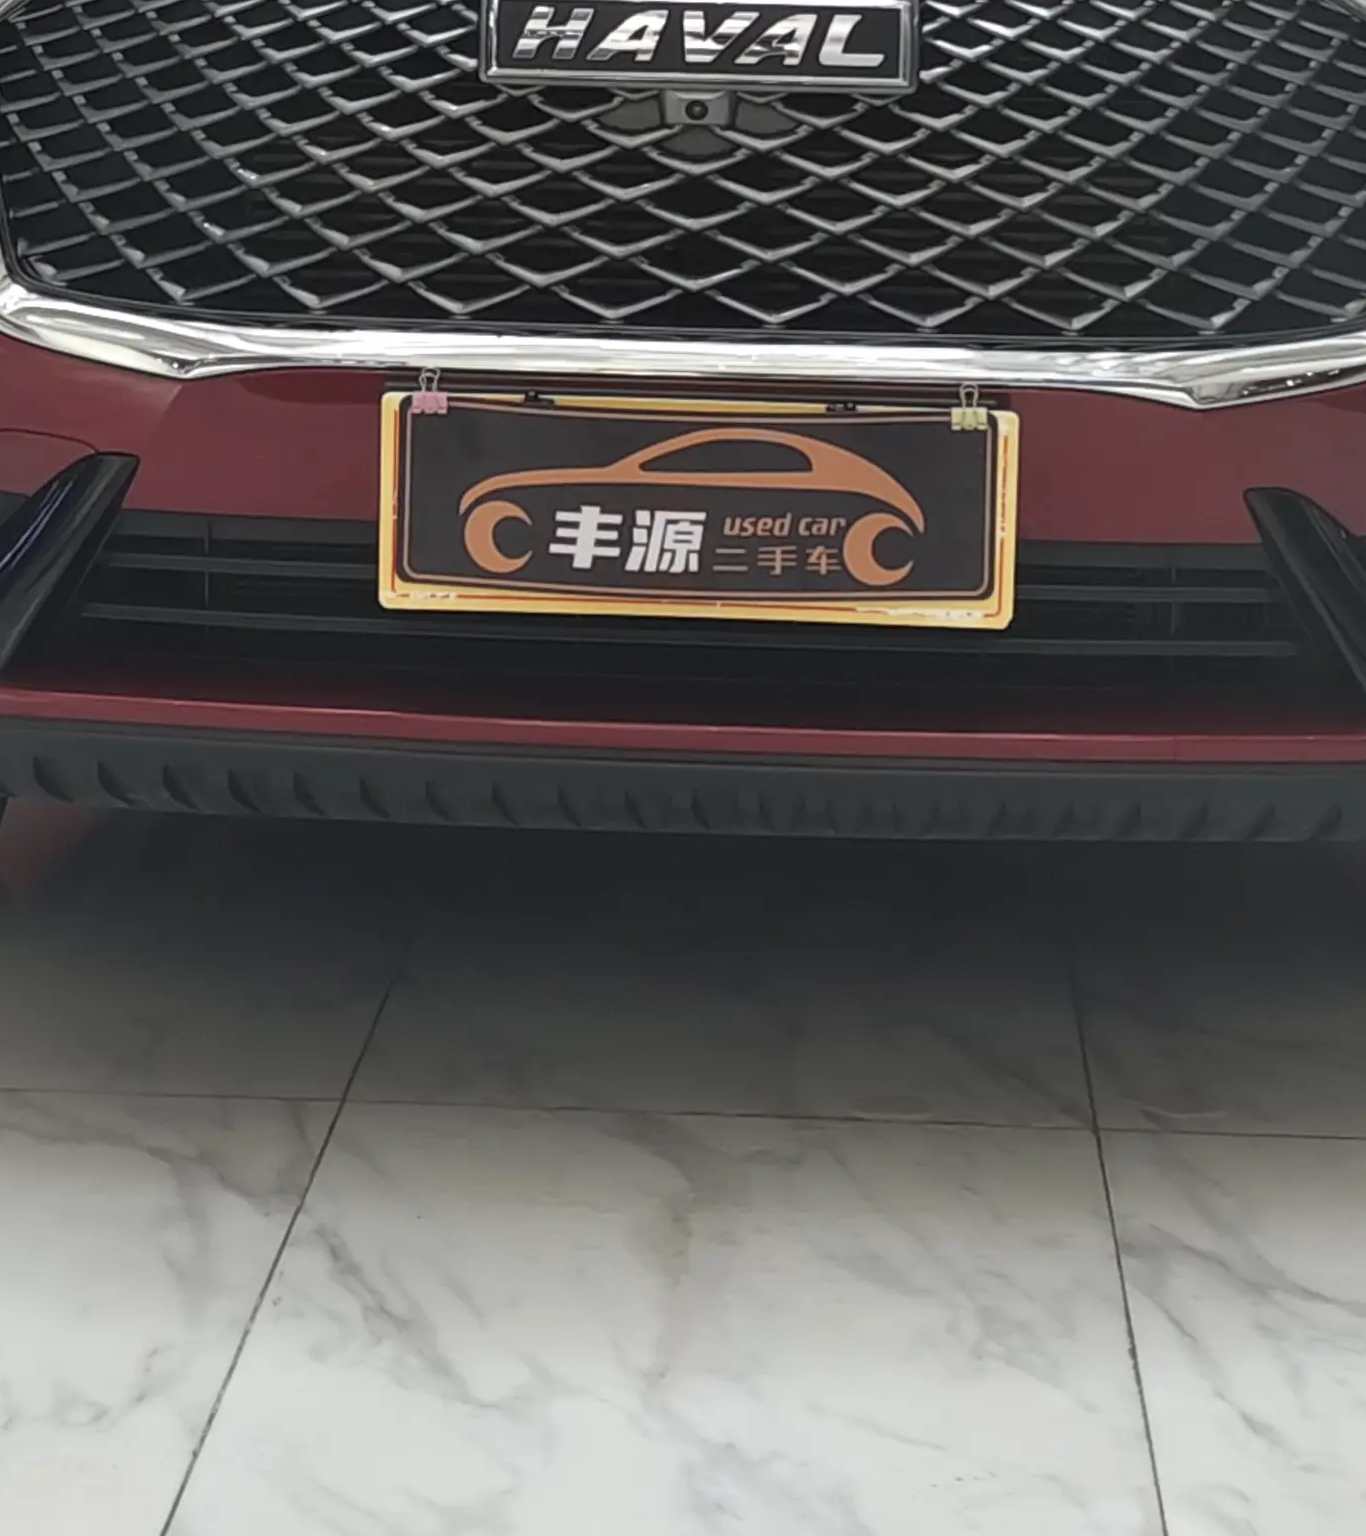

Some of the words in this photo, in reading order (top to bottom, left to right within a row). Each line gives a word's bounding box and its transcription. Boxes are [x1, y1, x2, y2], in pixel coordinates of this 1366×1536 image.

[511, 5, 887, 68] HAVAL
[548, 505, 707, 574] 丰源
[723, 512, 792, 537] used
[797, 515, 848, 537] car
[712, 545, 841, 576] 二手车
